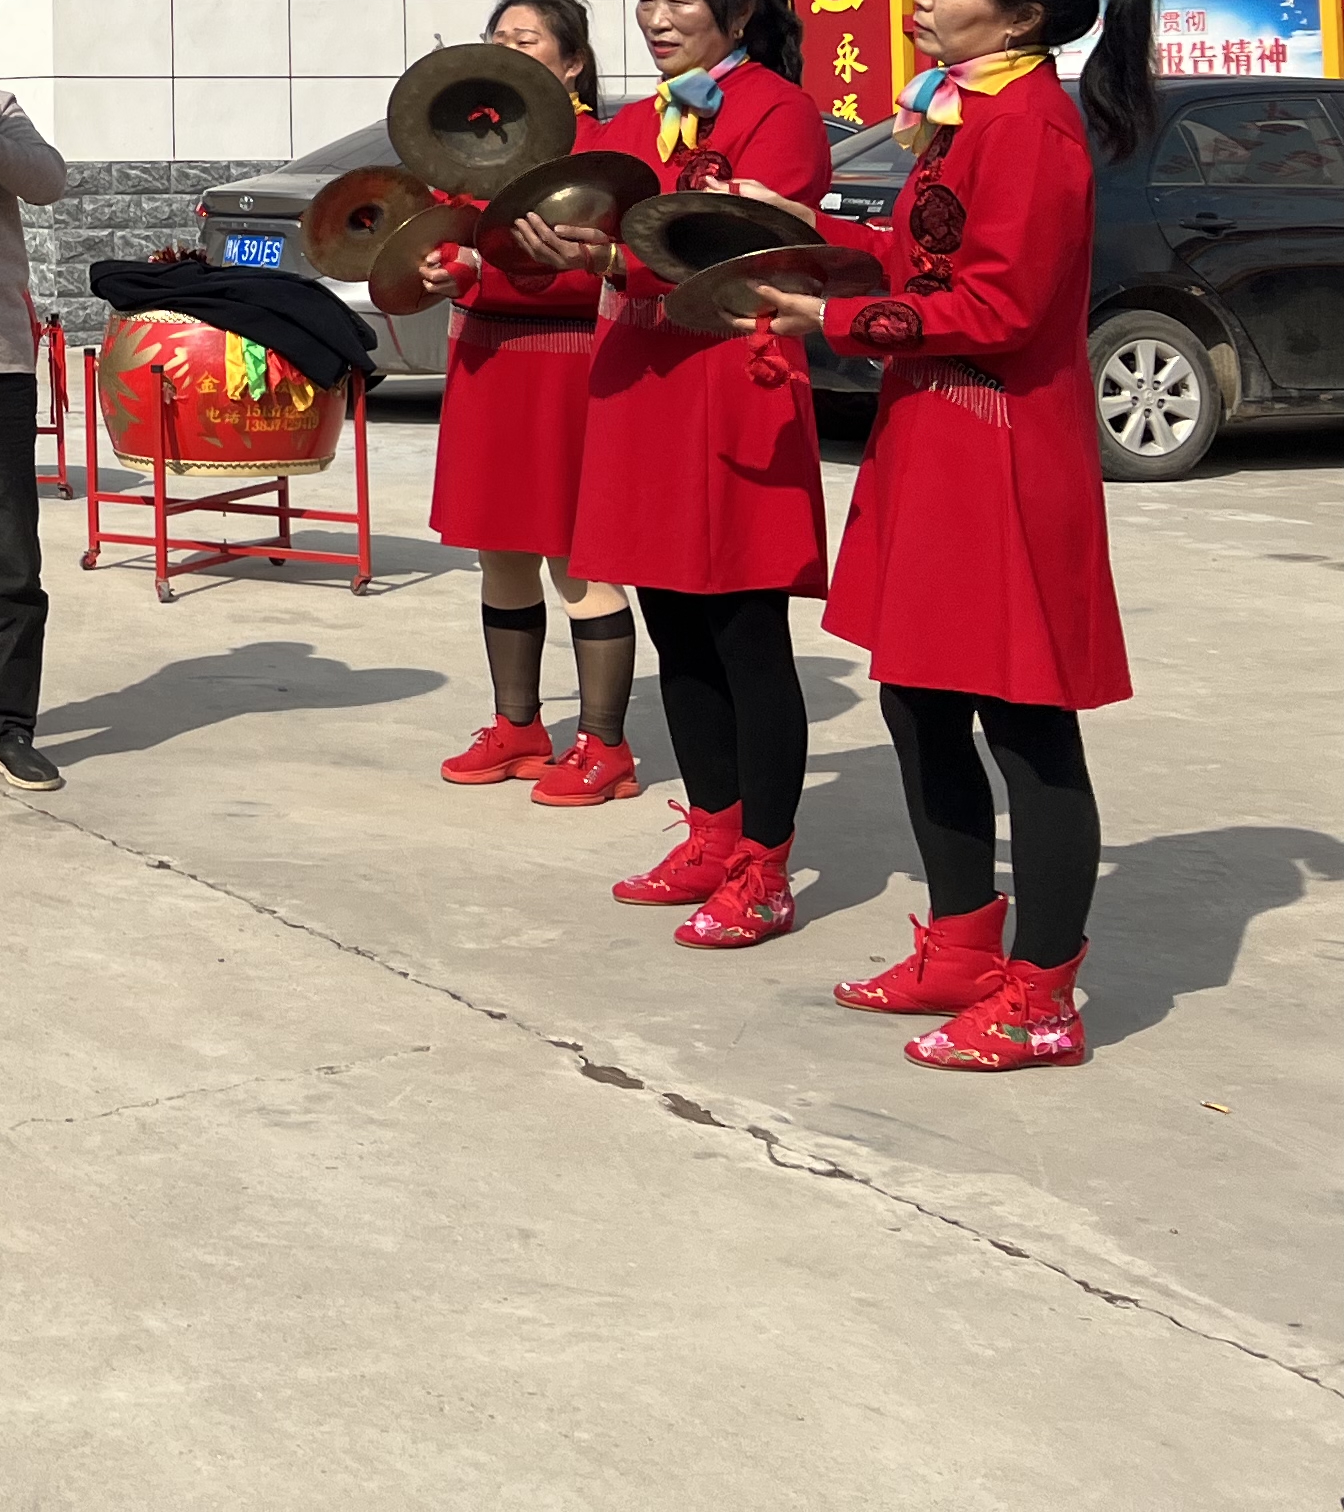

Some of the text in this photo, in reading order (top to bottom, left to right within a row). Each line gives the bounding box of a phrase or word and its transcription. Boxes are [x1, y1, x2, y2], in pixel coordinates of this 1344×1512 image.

[1160, 9, 1208, 34] 贯彻
[1157, 37, 1289, 76] 报告精神
[205, 407, 241, 425] 电话
